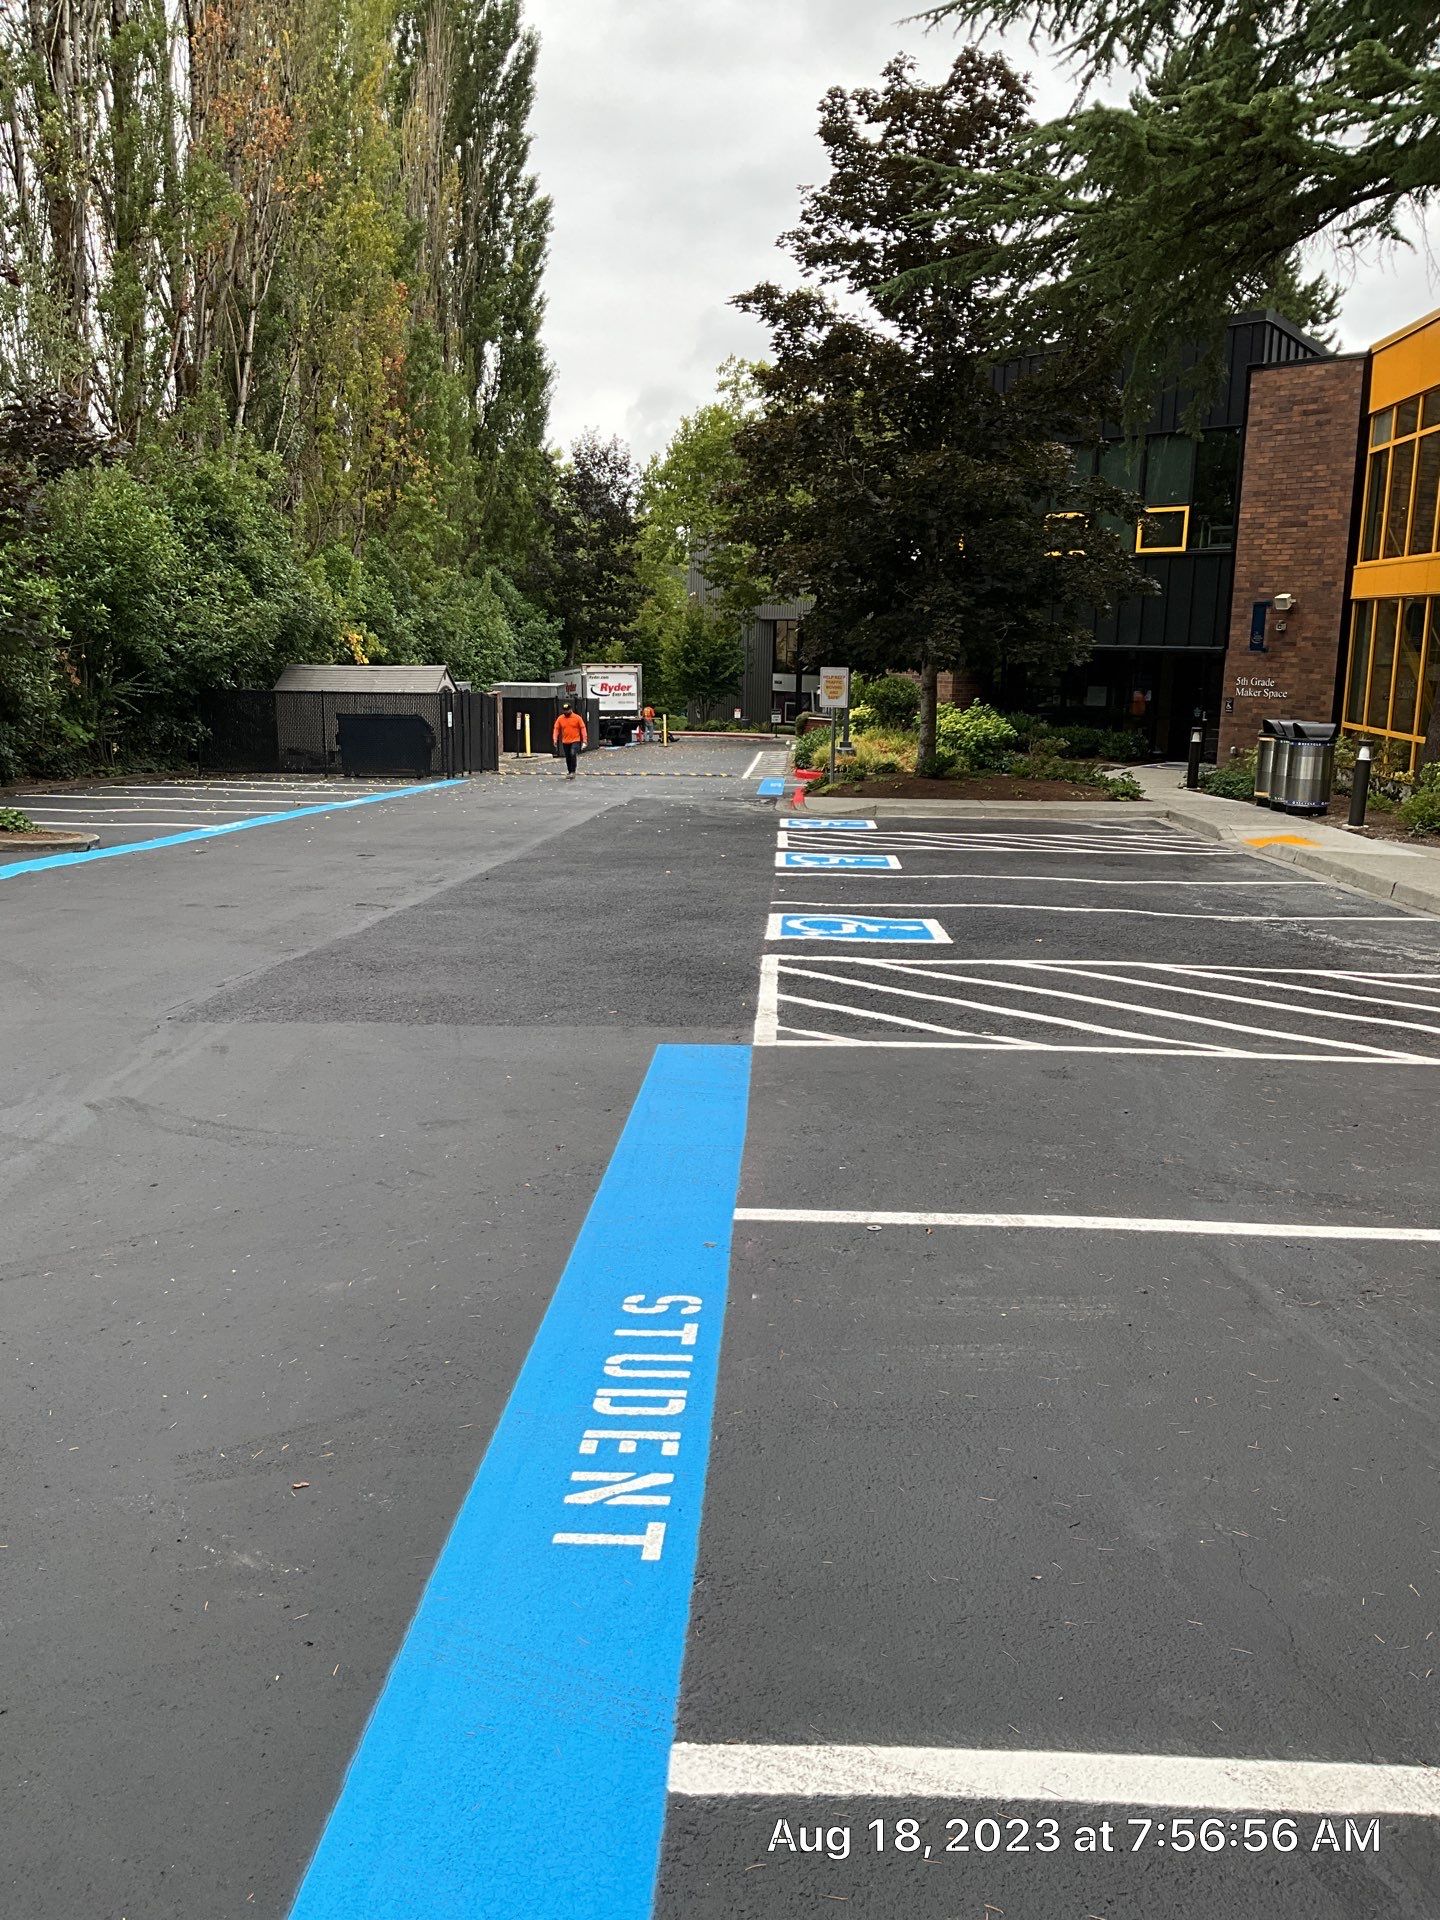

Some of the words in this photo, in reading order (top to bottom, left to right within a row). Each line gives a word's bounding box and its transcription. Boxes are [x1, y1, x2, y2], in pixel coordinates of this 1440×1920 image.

[1236, 677, 1249, 686] 5th
[1250, 677, 1275, 687] Grade
[600, 683, 632, 693] Ryder
[1235, 687, 1262, 697] Maker
[1263, 688, 1288, 699] Space
[552, 1294, 702, 1560] STUDENT
